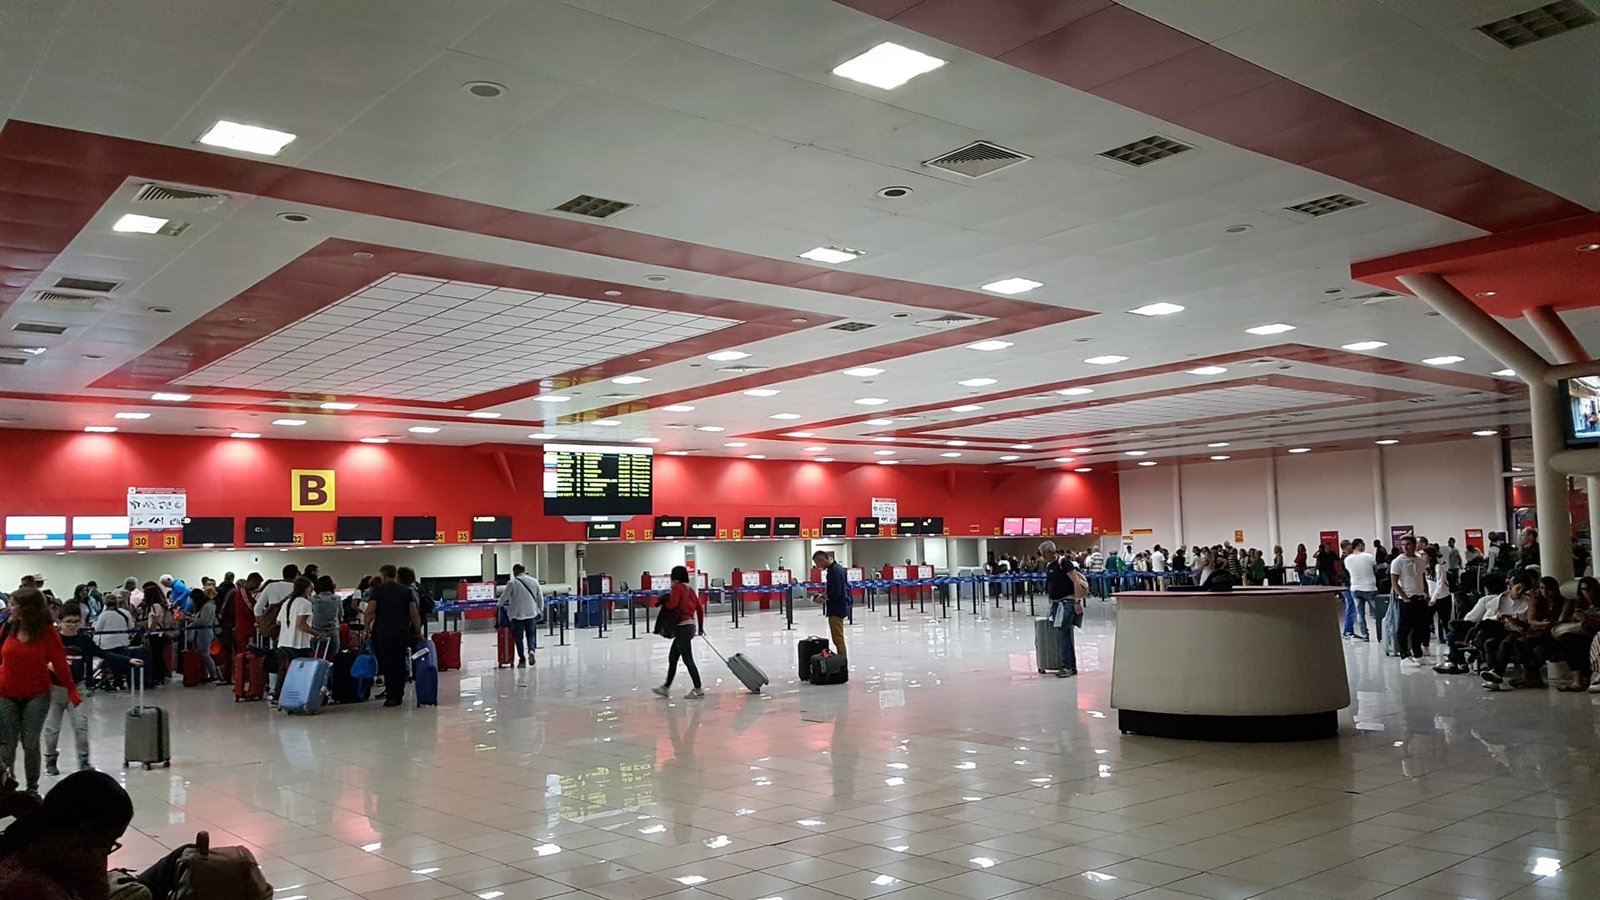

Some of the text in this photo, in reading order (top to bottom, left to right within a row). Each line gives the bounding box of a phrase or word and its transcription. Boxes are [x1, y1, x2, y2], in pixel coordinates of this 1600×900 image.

[299, 474, 328, 506] B
[135, 537, 147, 546] 30
[166, 537, 175, 546] 31
[293, 535, 302, 543] 32
[324, 535, 334, 543] 33
